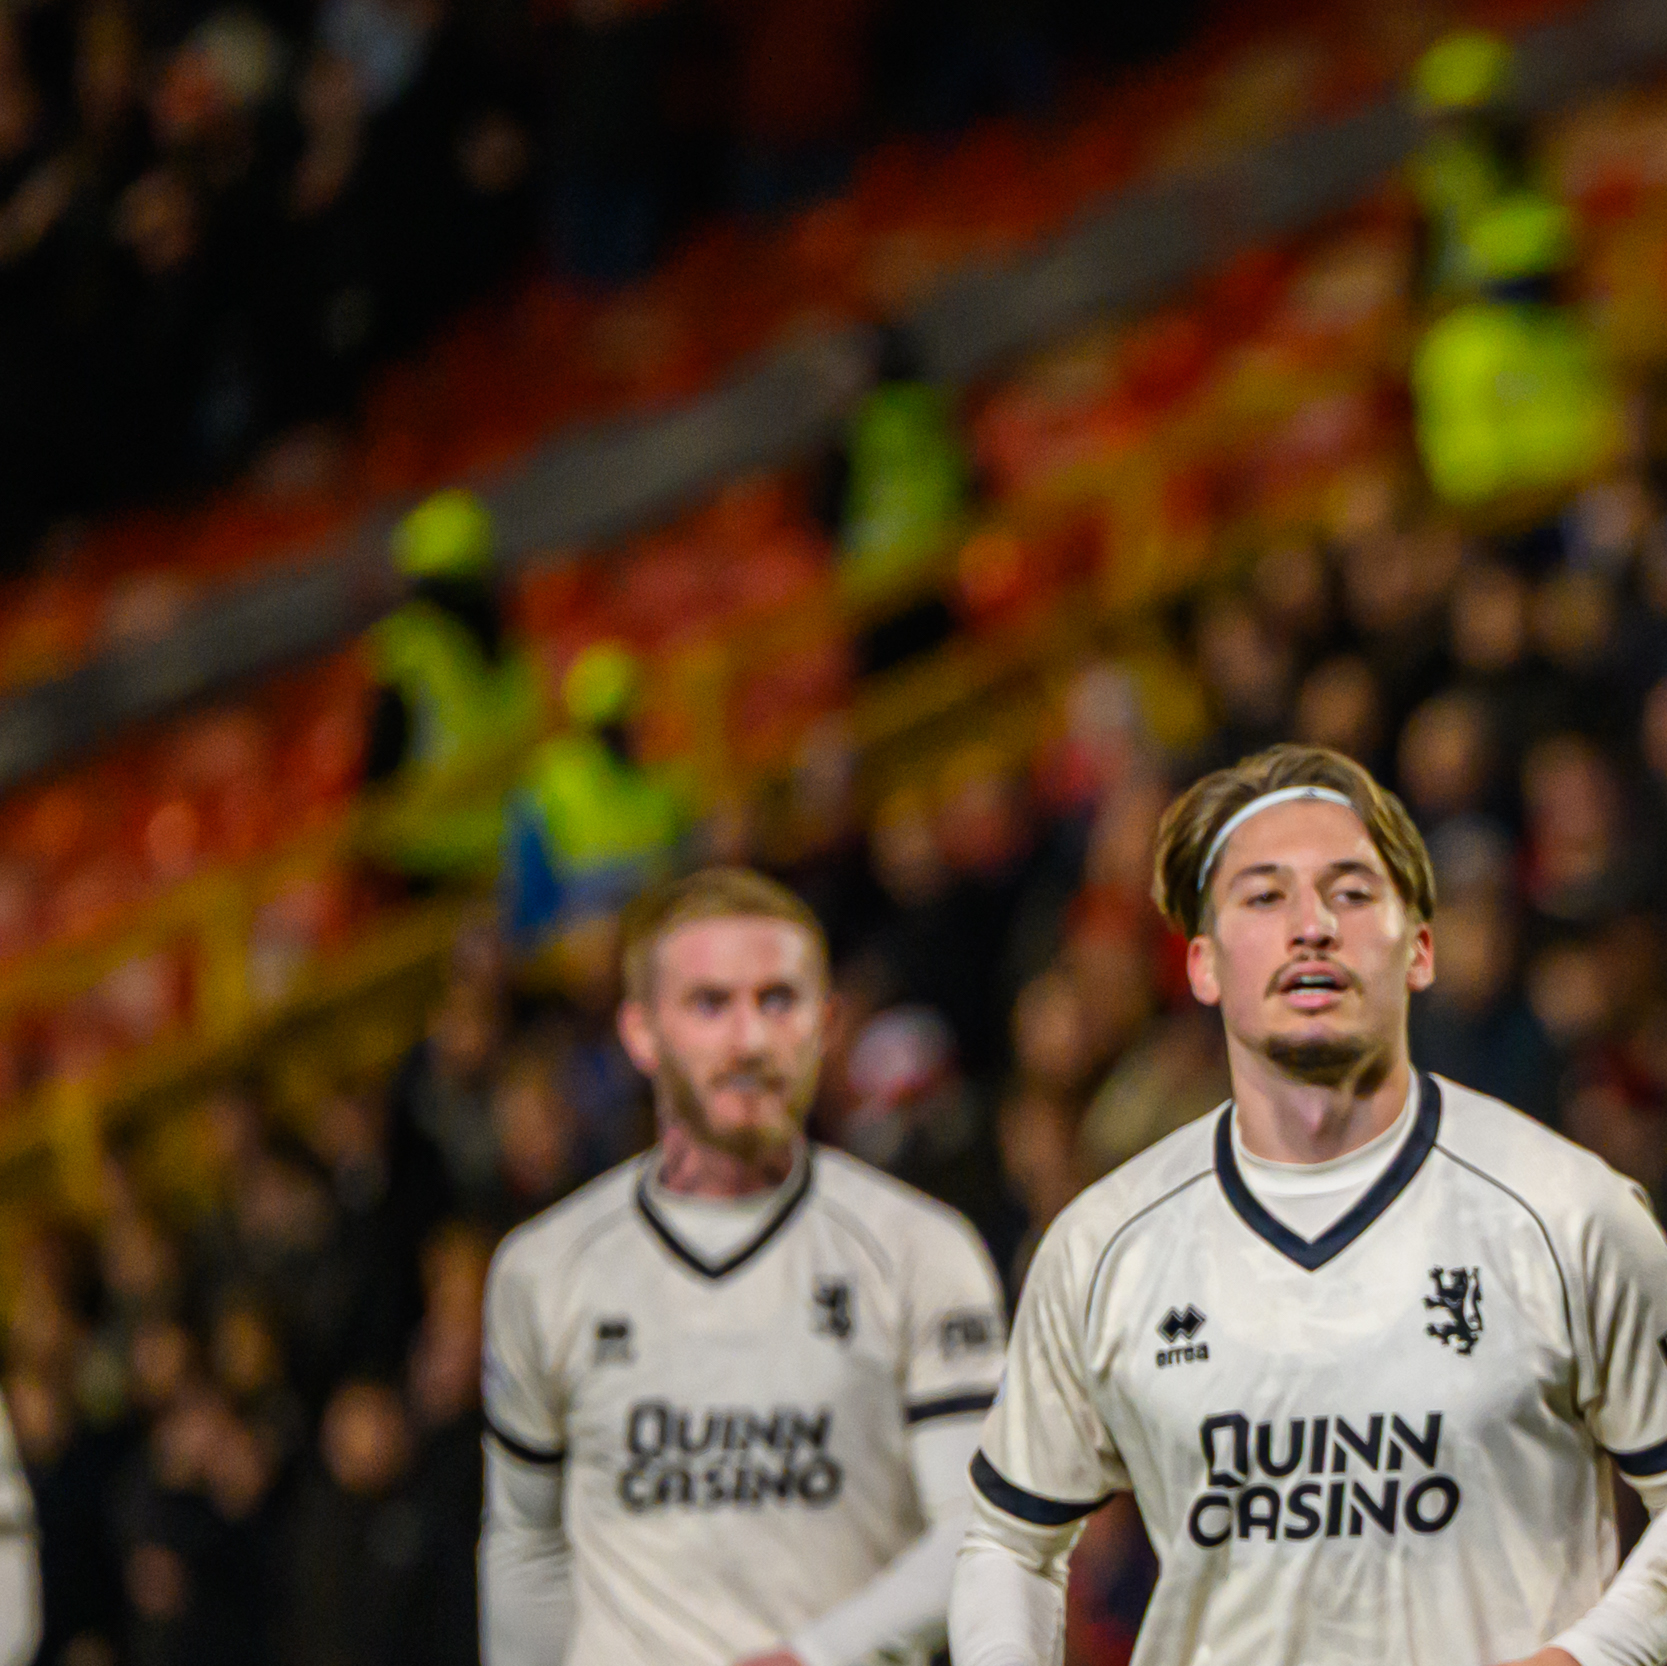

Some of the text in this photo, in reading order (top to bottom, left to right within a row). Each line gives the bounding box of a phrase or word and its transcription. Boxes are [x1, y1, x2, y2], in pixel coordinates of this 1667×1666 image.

[626, 1399, 832, 1458] QUINN
[1199, 1410, 1443, 1488] QUINN
[616, 1452, 843, 1513] CASINO
[1187, 1474, 1462, 1548] CASINO
